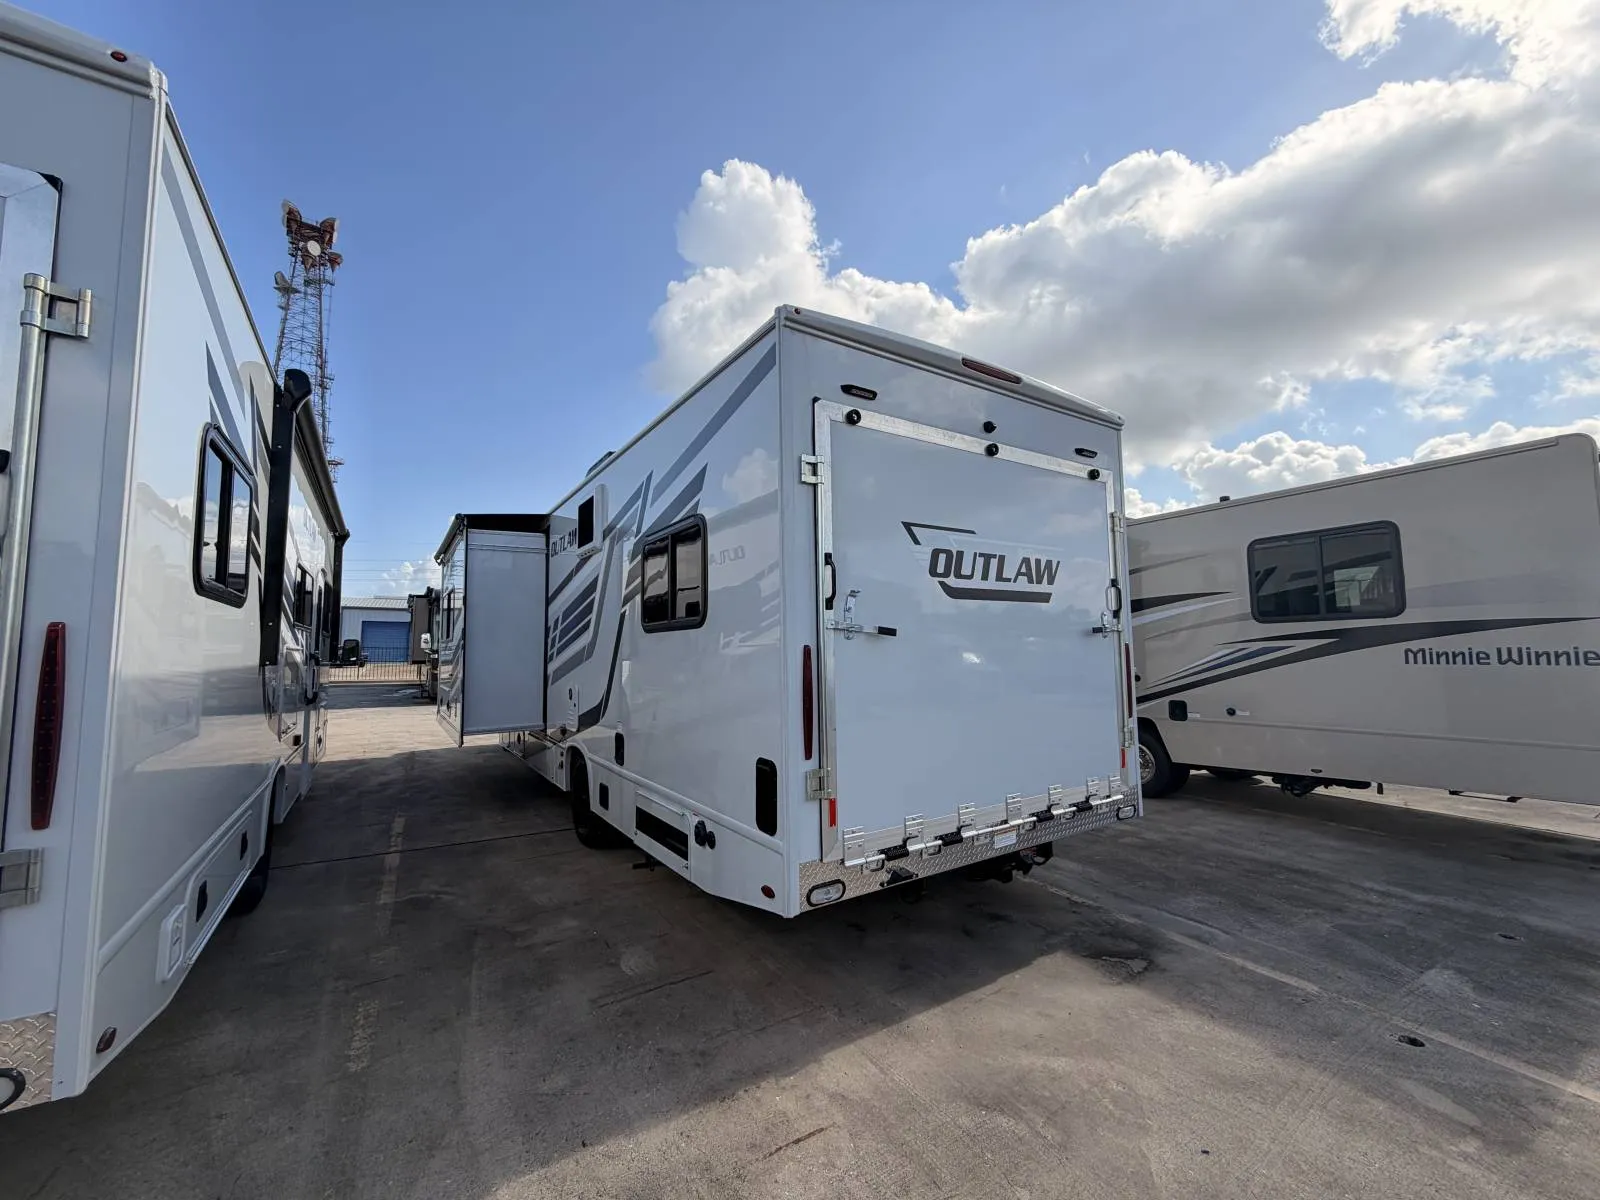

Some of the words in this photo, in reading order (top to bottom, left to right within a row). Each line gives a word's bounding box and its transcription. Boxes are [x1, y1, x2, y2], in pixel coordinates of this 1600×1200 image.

[928, 548, 1061, 586] OUTLAW
[1404, 647, 1491, 666] Minnie
[1497, 646, 1600, 667] Winnie
